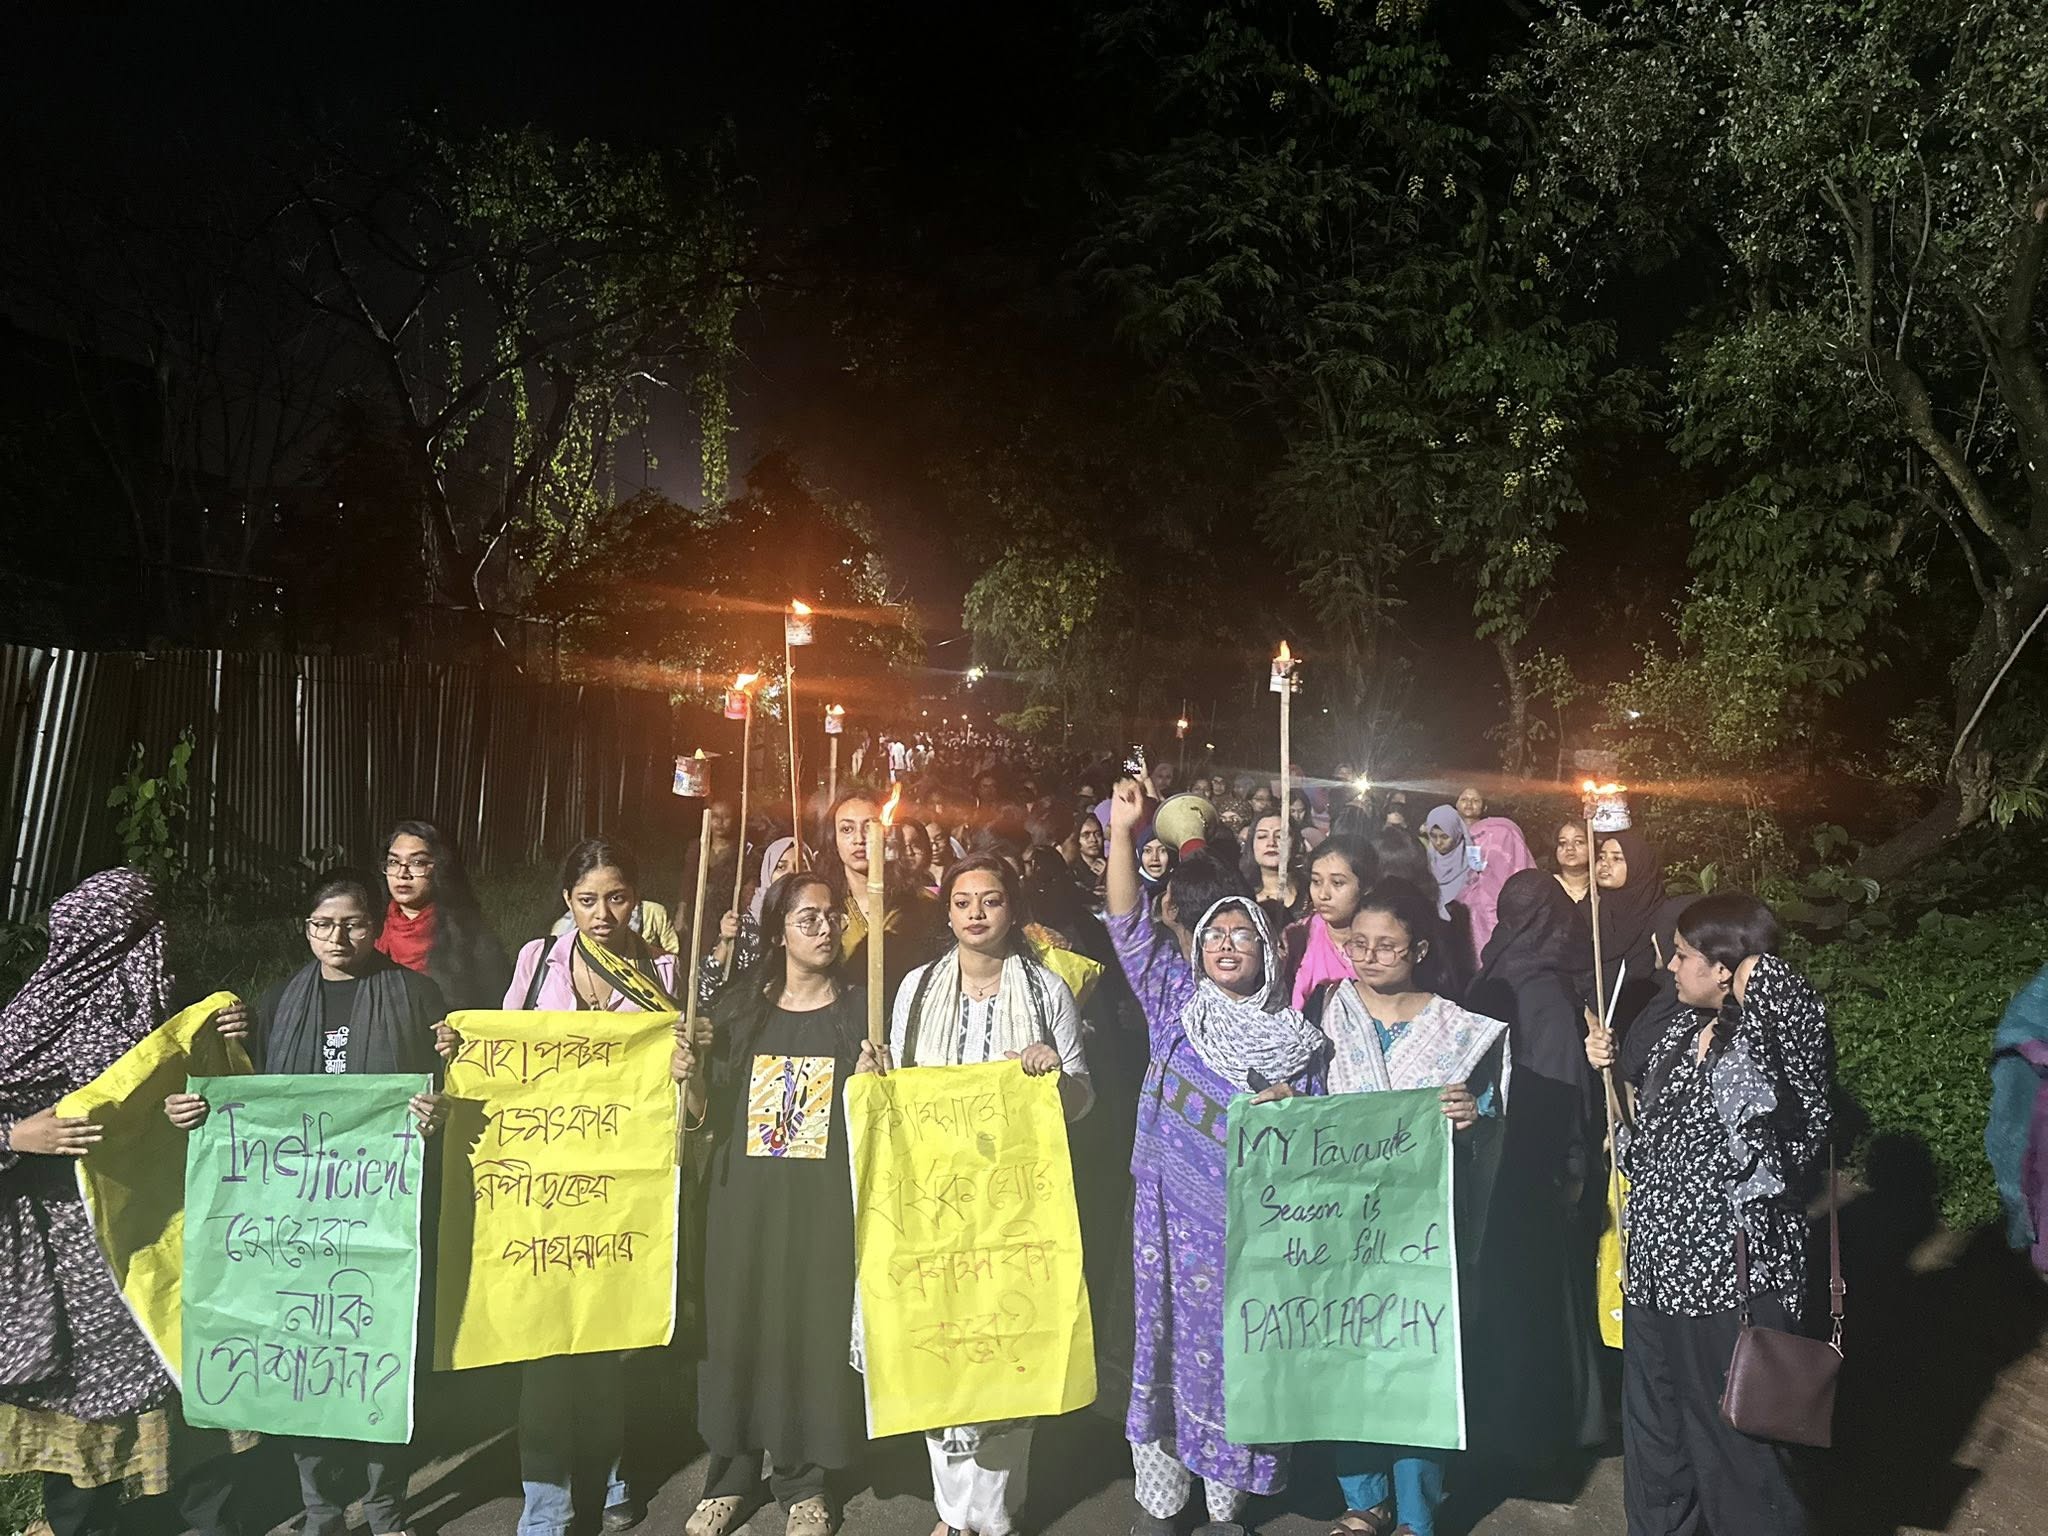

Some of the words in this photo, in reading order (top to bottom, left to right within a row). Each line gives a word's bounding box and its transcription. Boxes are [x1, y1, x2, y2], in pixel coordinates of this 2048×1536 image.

[487, 1103, 631, 1147] চমৎকার
[1237, 1125, 1297, 1168] MY
[217, 1102, 414, 1202] Inefficient
[1259, 1185, 1343, 1227] Season
[1362, 1193, 1381, 1223] is
[1283, 1236, 1331, 1268] the
[1352, 1227, 1390, 1266] fall
[1400, 1222, 1440, 1263] of
[276, 1269, 375, 1339] নাকি
[1240, 1293, 1446, 1354] PATRIARCHY
[196, 1334, 402, 1426] প্রশাসন?
